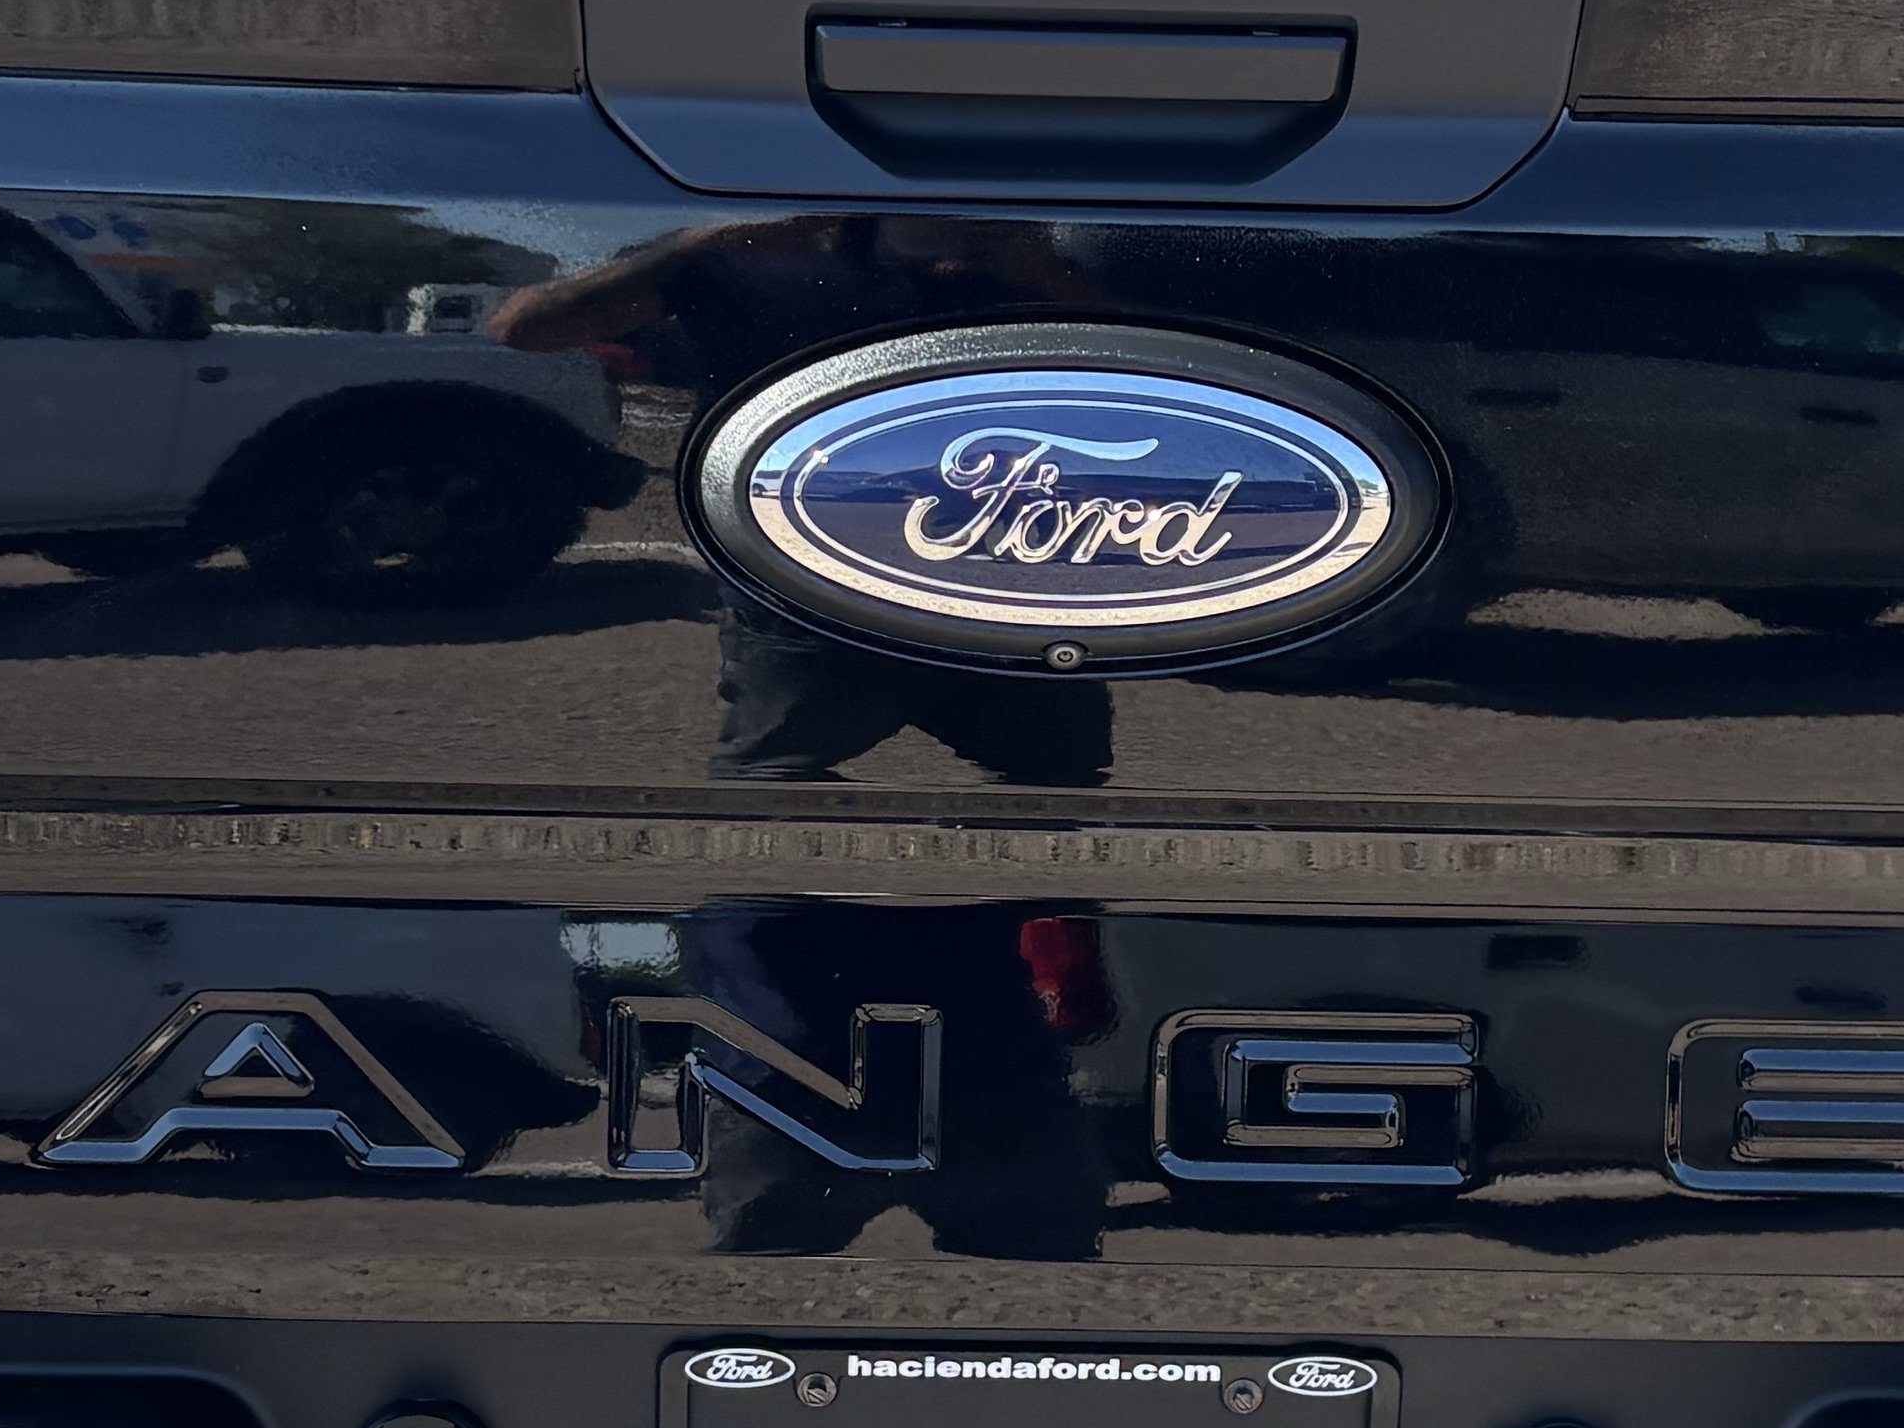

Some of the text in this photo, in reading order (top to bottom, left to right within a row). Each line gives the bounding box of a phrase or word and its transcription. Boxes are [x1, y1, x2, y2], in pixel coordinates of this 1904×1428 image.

[904, 426, 1244, 567] Ford
[705, 1353, 1354, 1391] Ford haciendaford.com Ford
